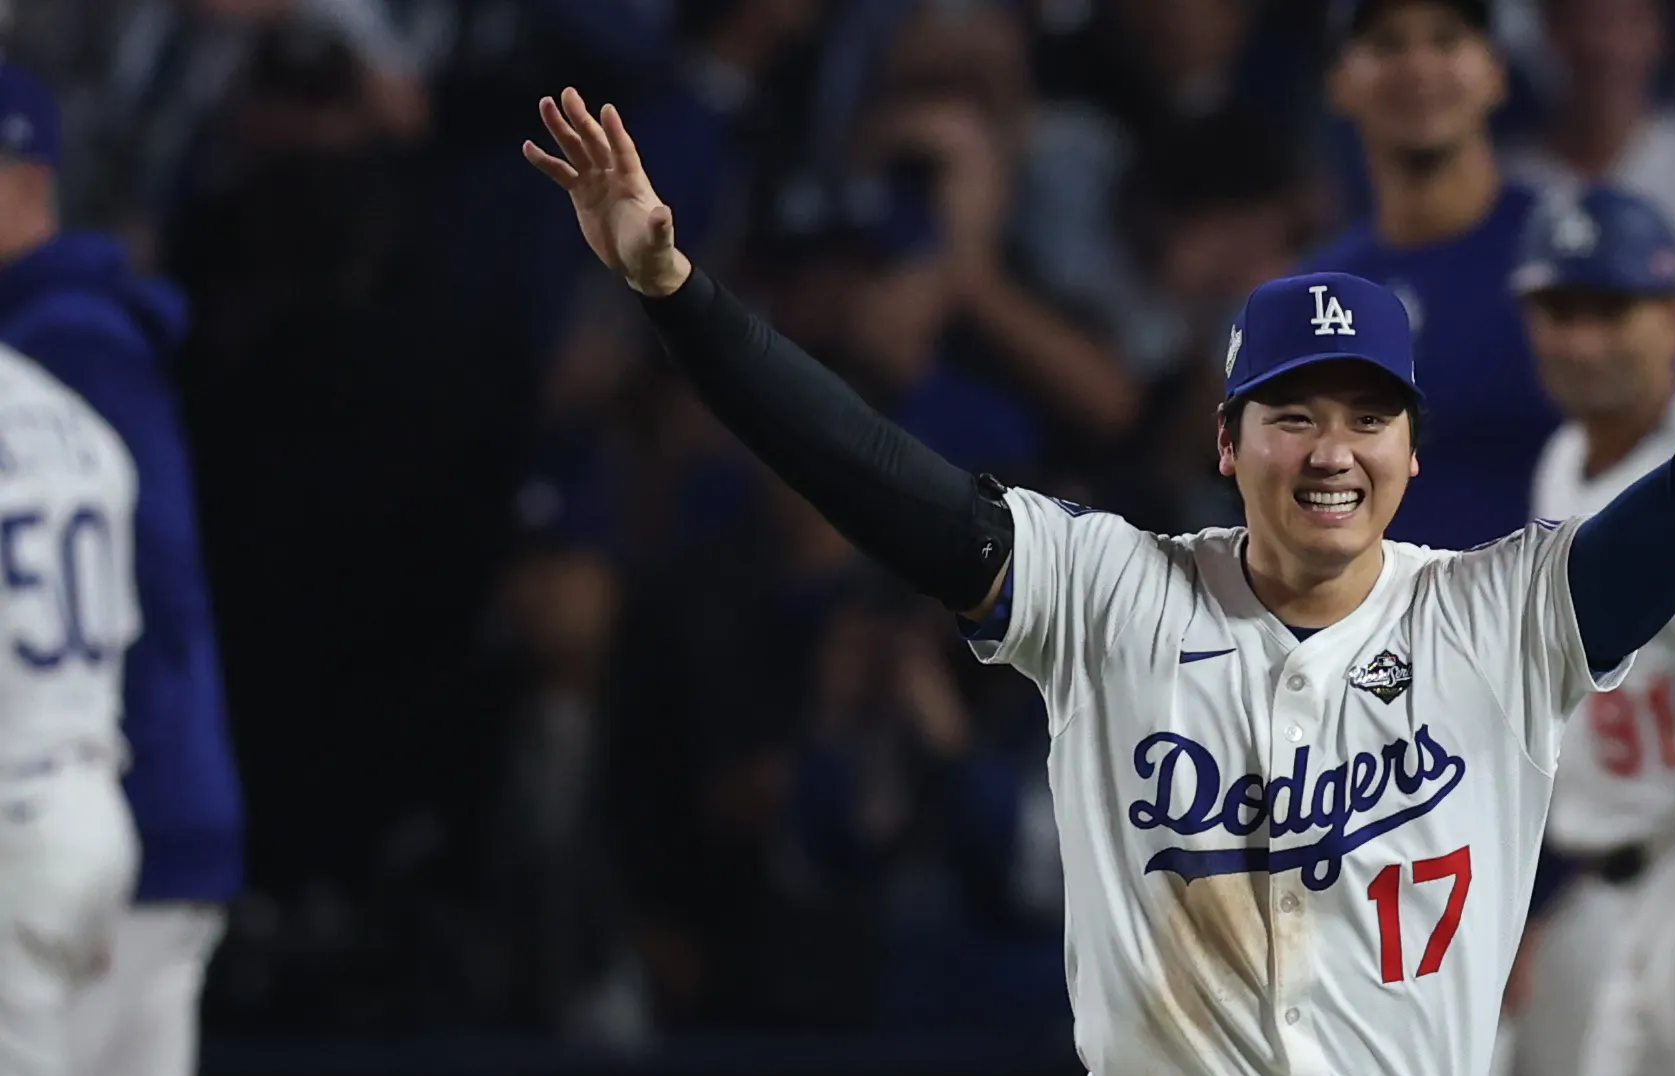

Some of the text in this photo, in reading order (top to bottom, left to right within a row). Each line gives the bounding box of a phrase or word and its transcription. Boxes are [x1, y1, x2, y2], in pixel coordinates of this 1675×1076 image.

[1309, 285, 1356, 336] LA
[0, 505, 113, 670] 50
[1129, 723, 1466, 891] Dodgers
[1367, 845, 1472, 984] 17
